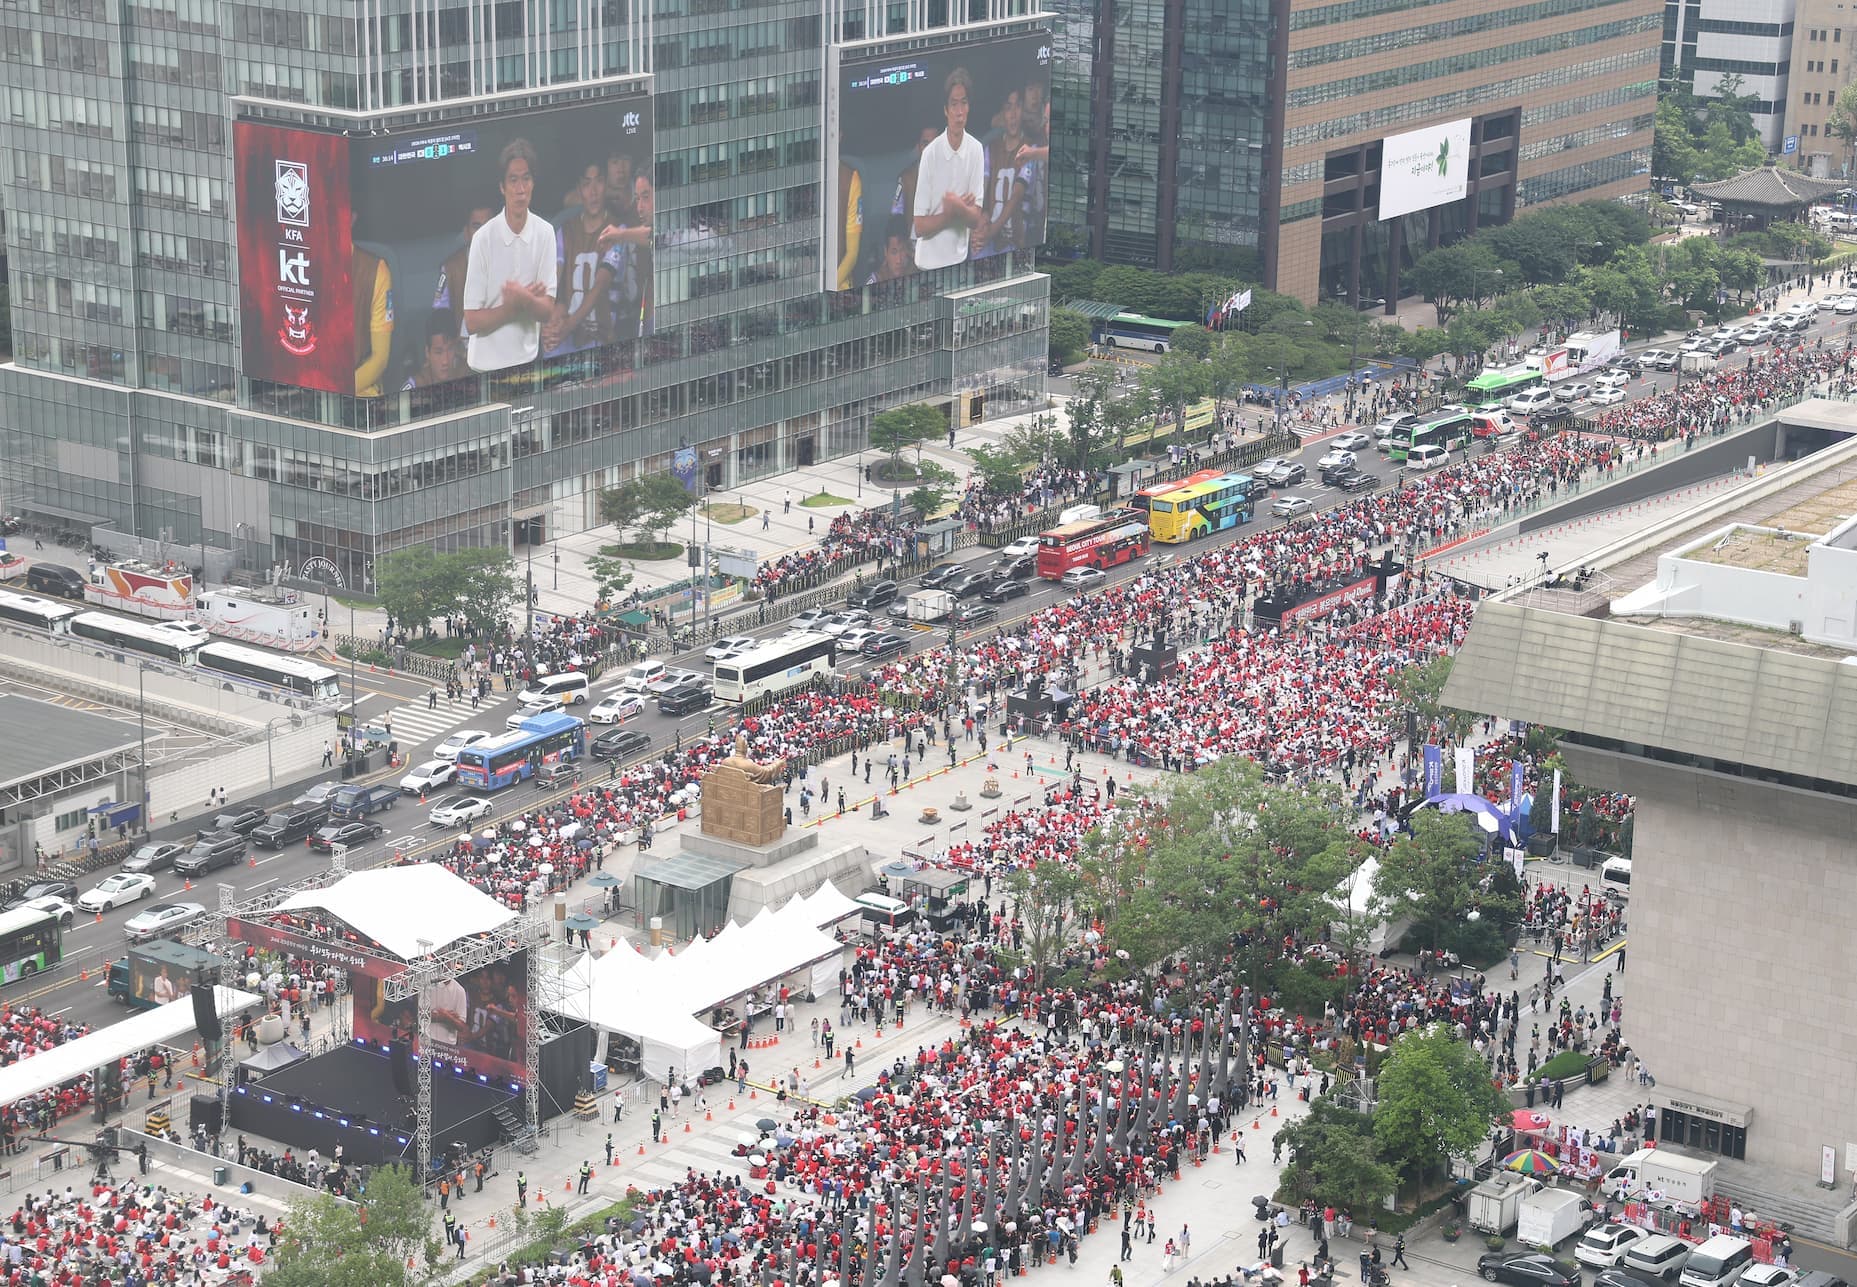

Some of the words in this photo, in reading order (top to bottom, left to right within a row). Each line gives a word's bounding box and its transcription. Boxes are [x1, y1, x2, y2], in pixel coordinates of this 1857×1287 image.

[285, 228, 303, 242] KFA
[279, 249, 310, 286] kt
[1066, 542, 1082, 553] SEOUL
[1081, 538, 1094, 549] CITY
[1093, 534, 1106, 546] TOUR
[318, 559, 344, 588] JOURNEY
[1657, 1175, 1665, 1183] kt
